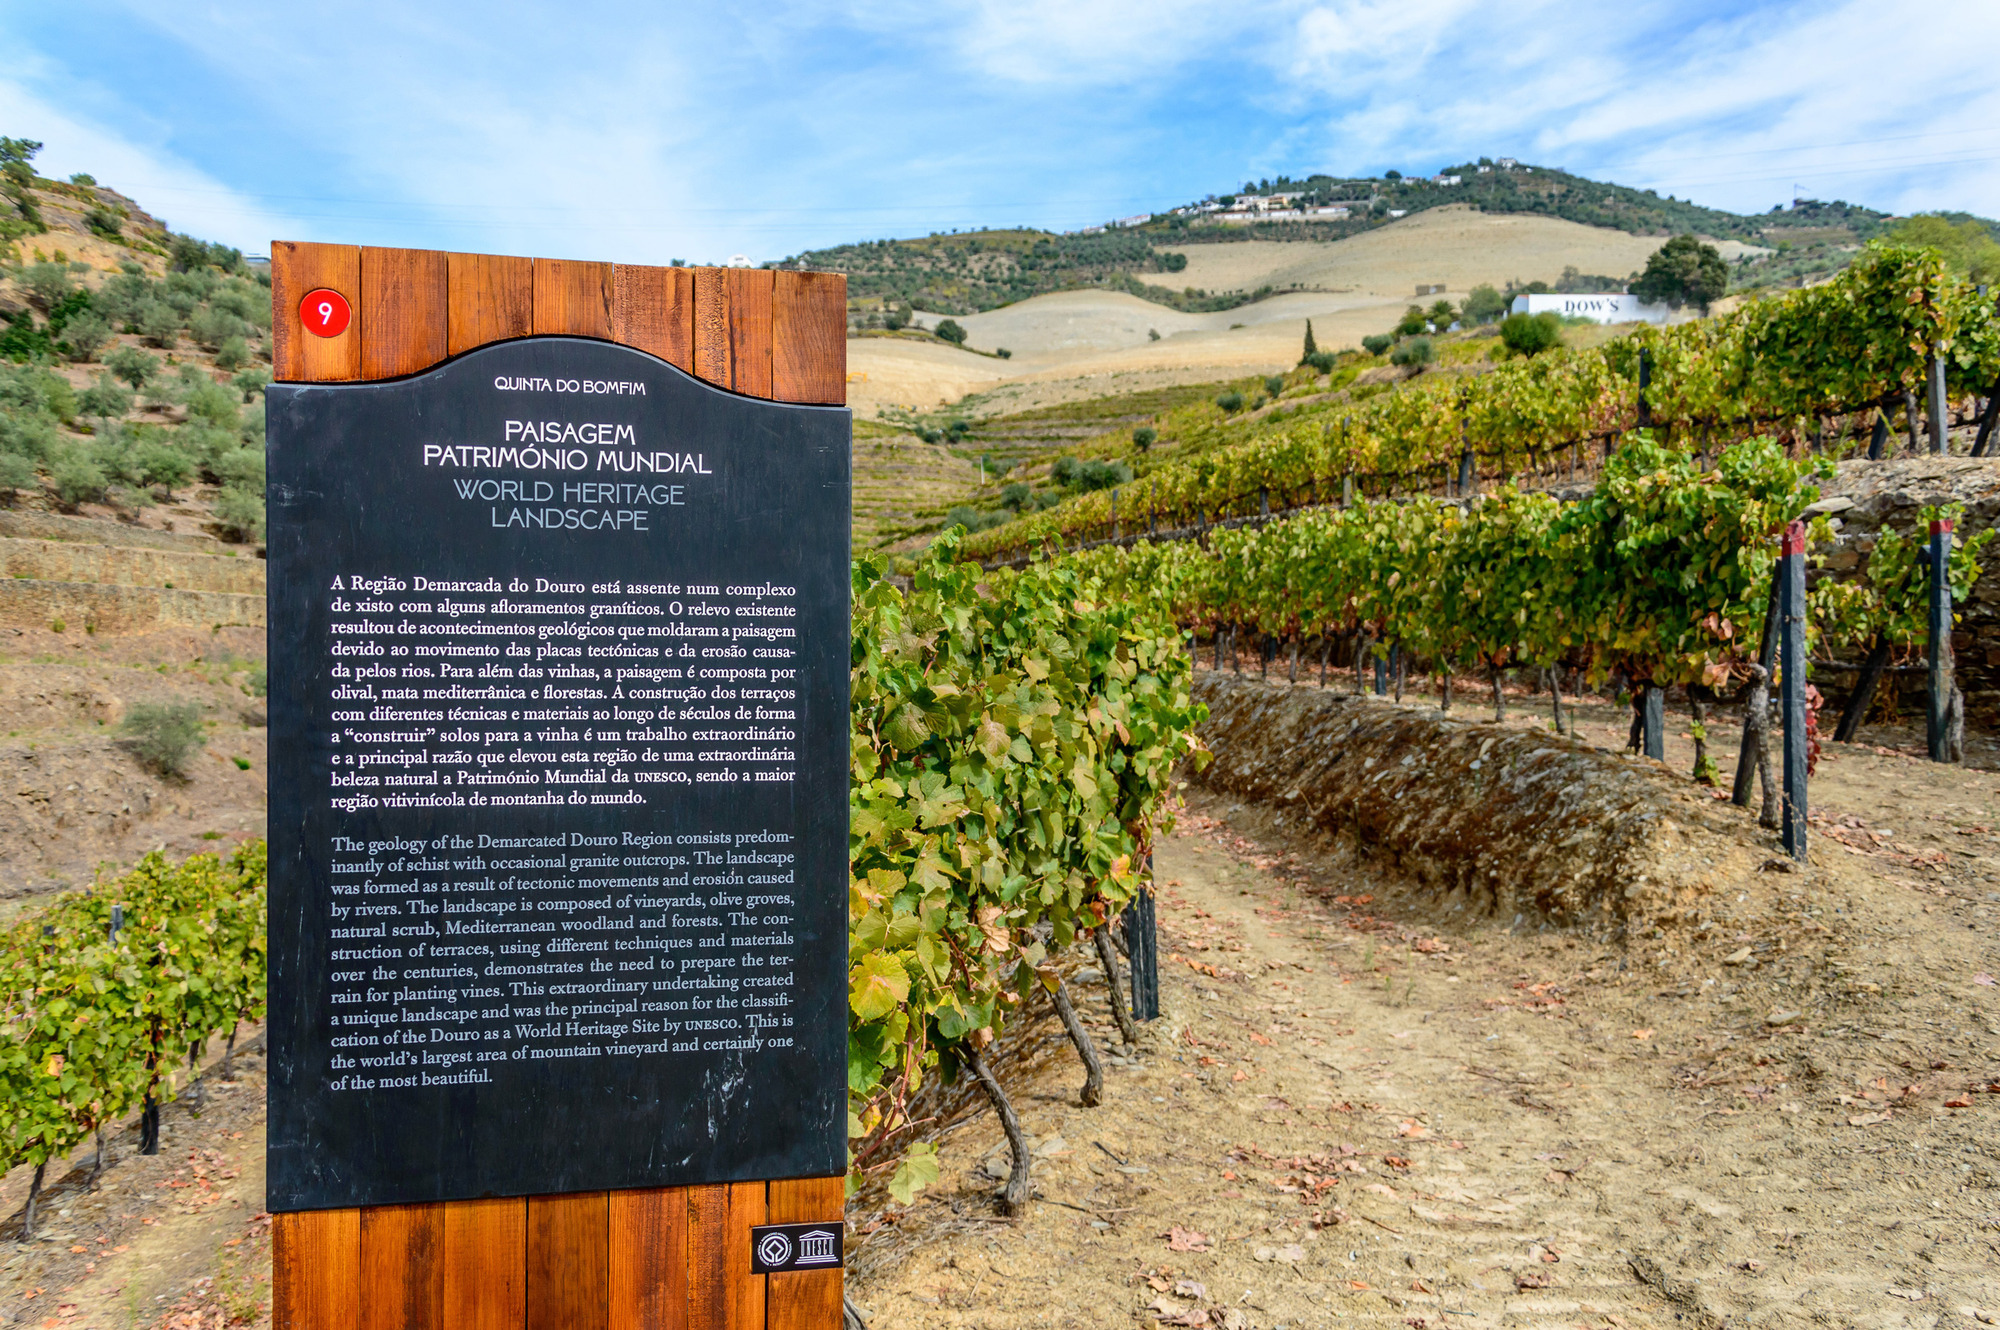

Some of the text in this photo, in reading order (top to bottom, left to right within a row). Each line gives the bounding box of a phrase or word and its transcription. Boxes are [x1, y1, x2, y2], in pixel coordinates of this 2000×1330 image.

[318, 302, 332, 325] 9
[494, 376, 646, 396] QUINTA DO BOMFIM
[505, 420, 636, 446] PAISAGEM
[423, 443, 712, 474] PATRIMÓNIO MUNDIAL
[453, 479, 685, 505] WORLD HERITAGE
[491, 507, 649, 530] LANDSCAPE
[330, 574, 796, 600] A Região Demarcada do Douro está assente num complexo
[331, 596, 796, 619] de xisto com alguns afloramentos graníticos. O relevo existente
[331, 619, 796, 642] resultou de acontecimentos geológicos que moldaram a paisagem
[331, 684, 796, 703] olival, mata mediterrânica e florestas. A construção dos terraços
[331, 733, 341, 743] a
[440, 727, 480, 742] solos
[484, 732, 519, 746] para
[524, 732, 533, 742] a
[536, 727, 579, 742] vinha
[584, 727, 592, 741] é
[596, 731, 622, 741] um
[626, 726, 687, 741] trabalho
[692, 726, 796, 741] extraordinário
[331, 767, 796, 787] beleza natural a Património Mundial da UNESCO, sendo a maior
[331, 789, 647, 813] região vitivinícola de montanha do mundo.
[331, 829, 795, 855] The geology of the Demarcated Douro Region consists predom-
[331, 850, 795, 877] inantly of schist with occasional granite outcrops. The landscape
[331, 912, 794, 938] natural scrub, Mediterranean woodland and forests. The con-
[331, 931, 794, 960] struction of terraces, using different techniques and materials
[331, 952, 794, 982] over the centuries, demonstrates the need to prepare the ter-
[331, 972, 794, 1005] rain for planting vines. This extraordinary undertaking created
[330, 1013, 794, 1048] cation of the Douro as a World Heritage Site by UNESCO. This is
[330, 1054, 356, 1069] the
[422, 1050, 473, 1068] largest
[476, 1050, 508, 1061] area
[512, 1045, 529, 1059] of
[530, 1042, 602, 1059] mountain
[605, 1039, 668, 1059] vineyard
[672, 1037, 699, 1052] and
[703, 1035, 764, 1052] certainly
[768, 1037, 794, 1048] one
[330, 1069, 493, 1091] of the most beautiful.
